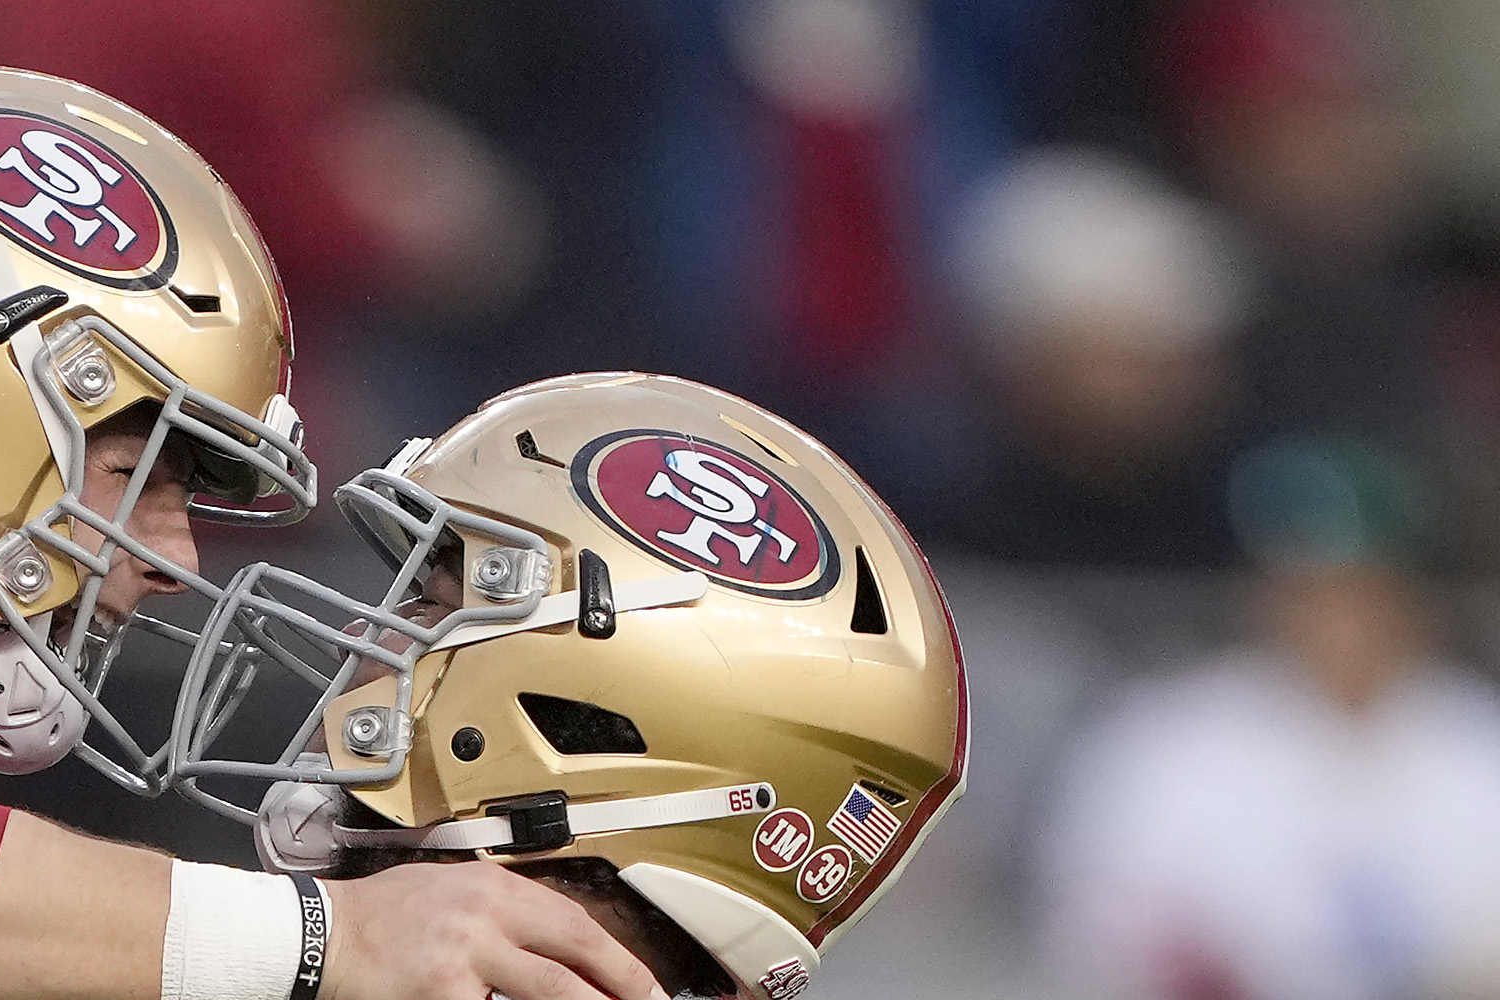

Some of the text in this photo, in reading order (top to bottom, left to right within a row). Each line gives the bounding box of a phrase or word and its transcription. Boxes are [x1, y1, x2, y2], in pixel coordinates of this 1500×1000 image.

[729, 788, 754, 812] 65
[758, 817, 809, 863] JM
[805, 852, 847, 897] 39
